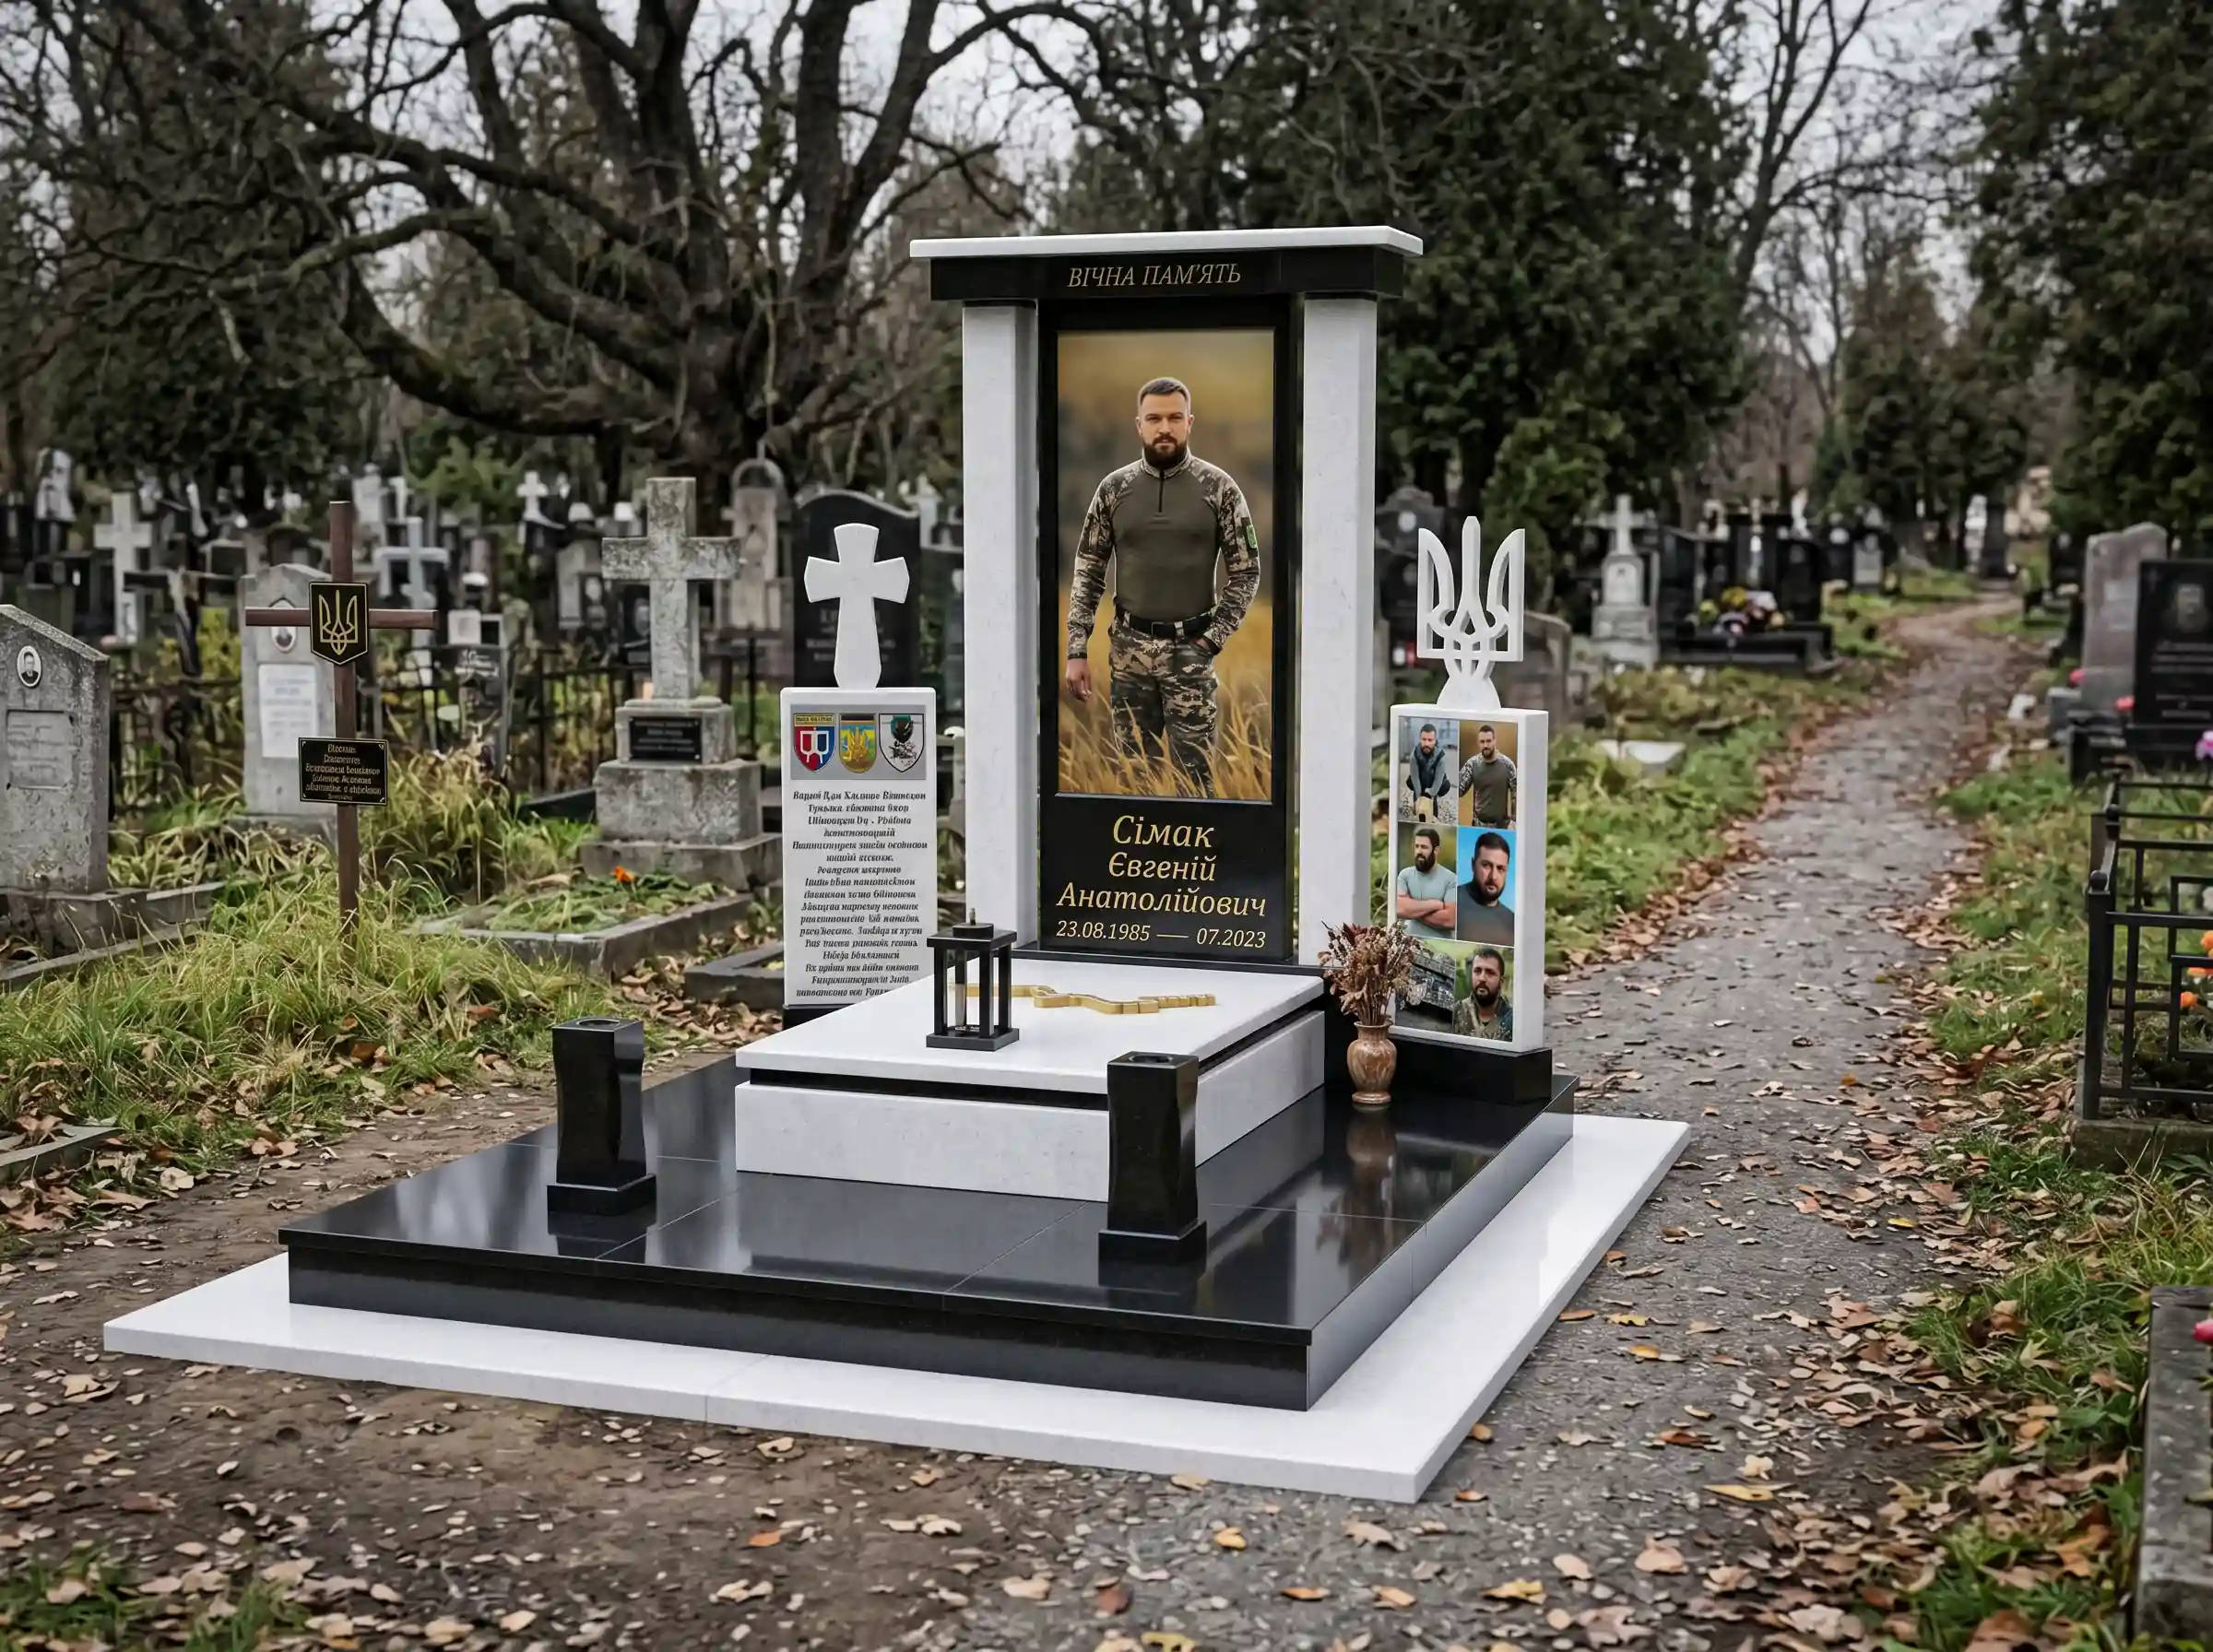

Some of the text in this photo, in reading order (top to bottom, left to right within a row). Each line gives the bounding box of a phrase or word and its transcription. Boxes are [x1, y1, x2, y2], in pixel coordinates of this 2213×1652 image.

[1067, 263, 1241, 288] ВІЧНА ПАМ’ЯТЬ
[1112, 815, 1214, 848] Сімак
[1108, 851, 1217, 881] Євгеній
[1056, 882, 1266, 916] Анатолійович
[1056, 920, 1151, 941] 23.08.1985
[1196, 927, 1266, 949] 07.2023
